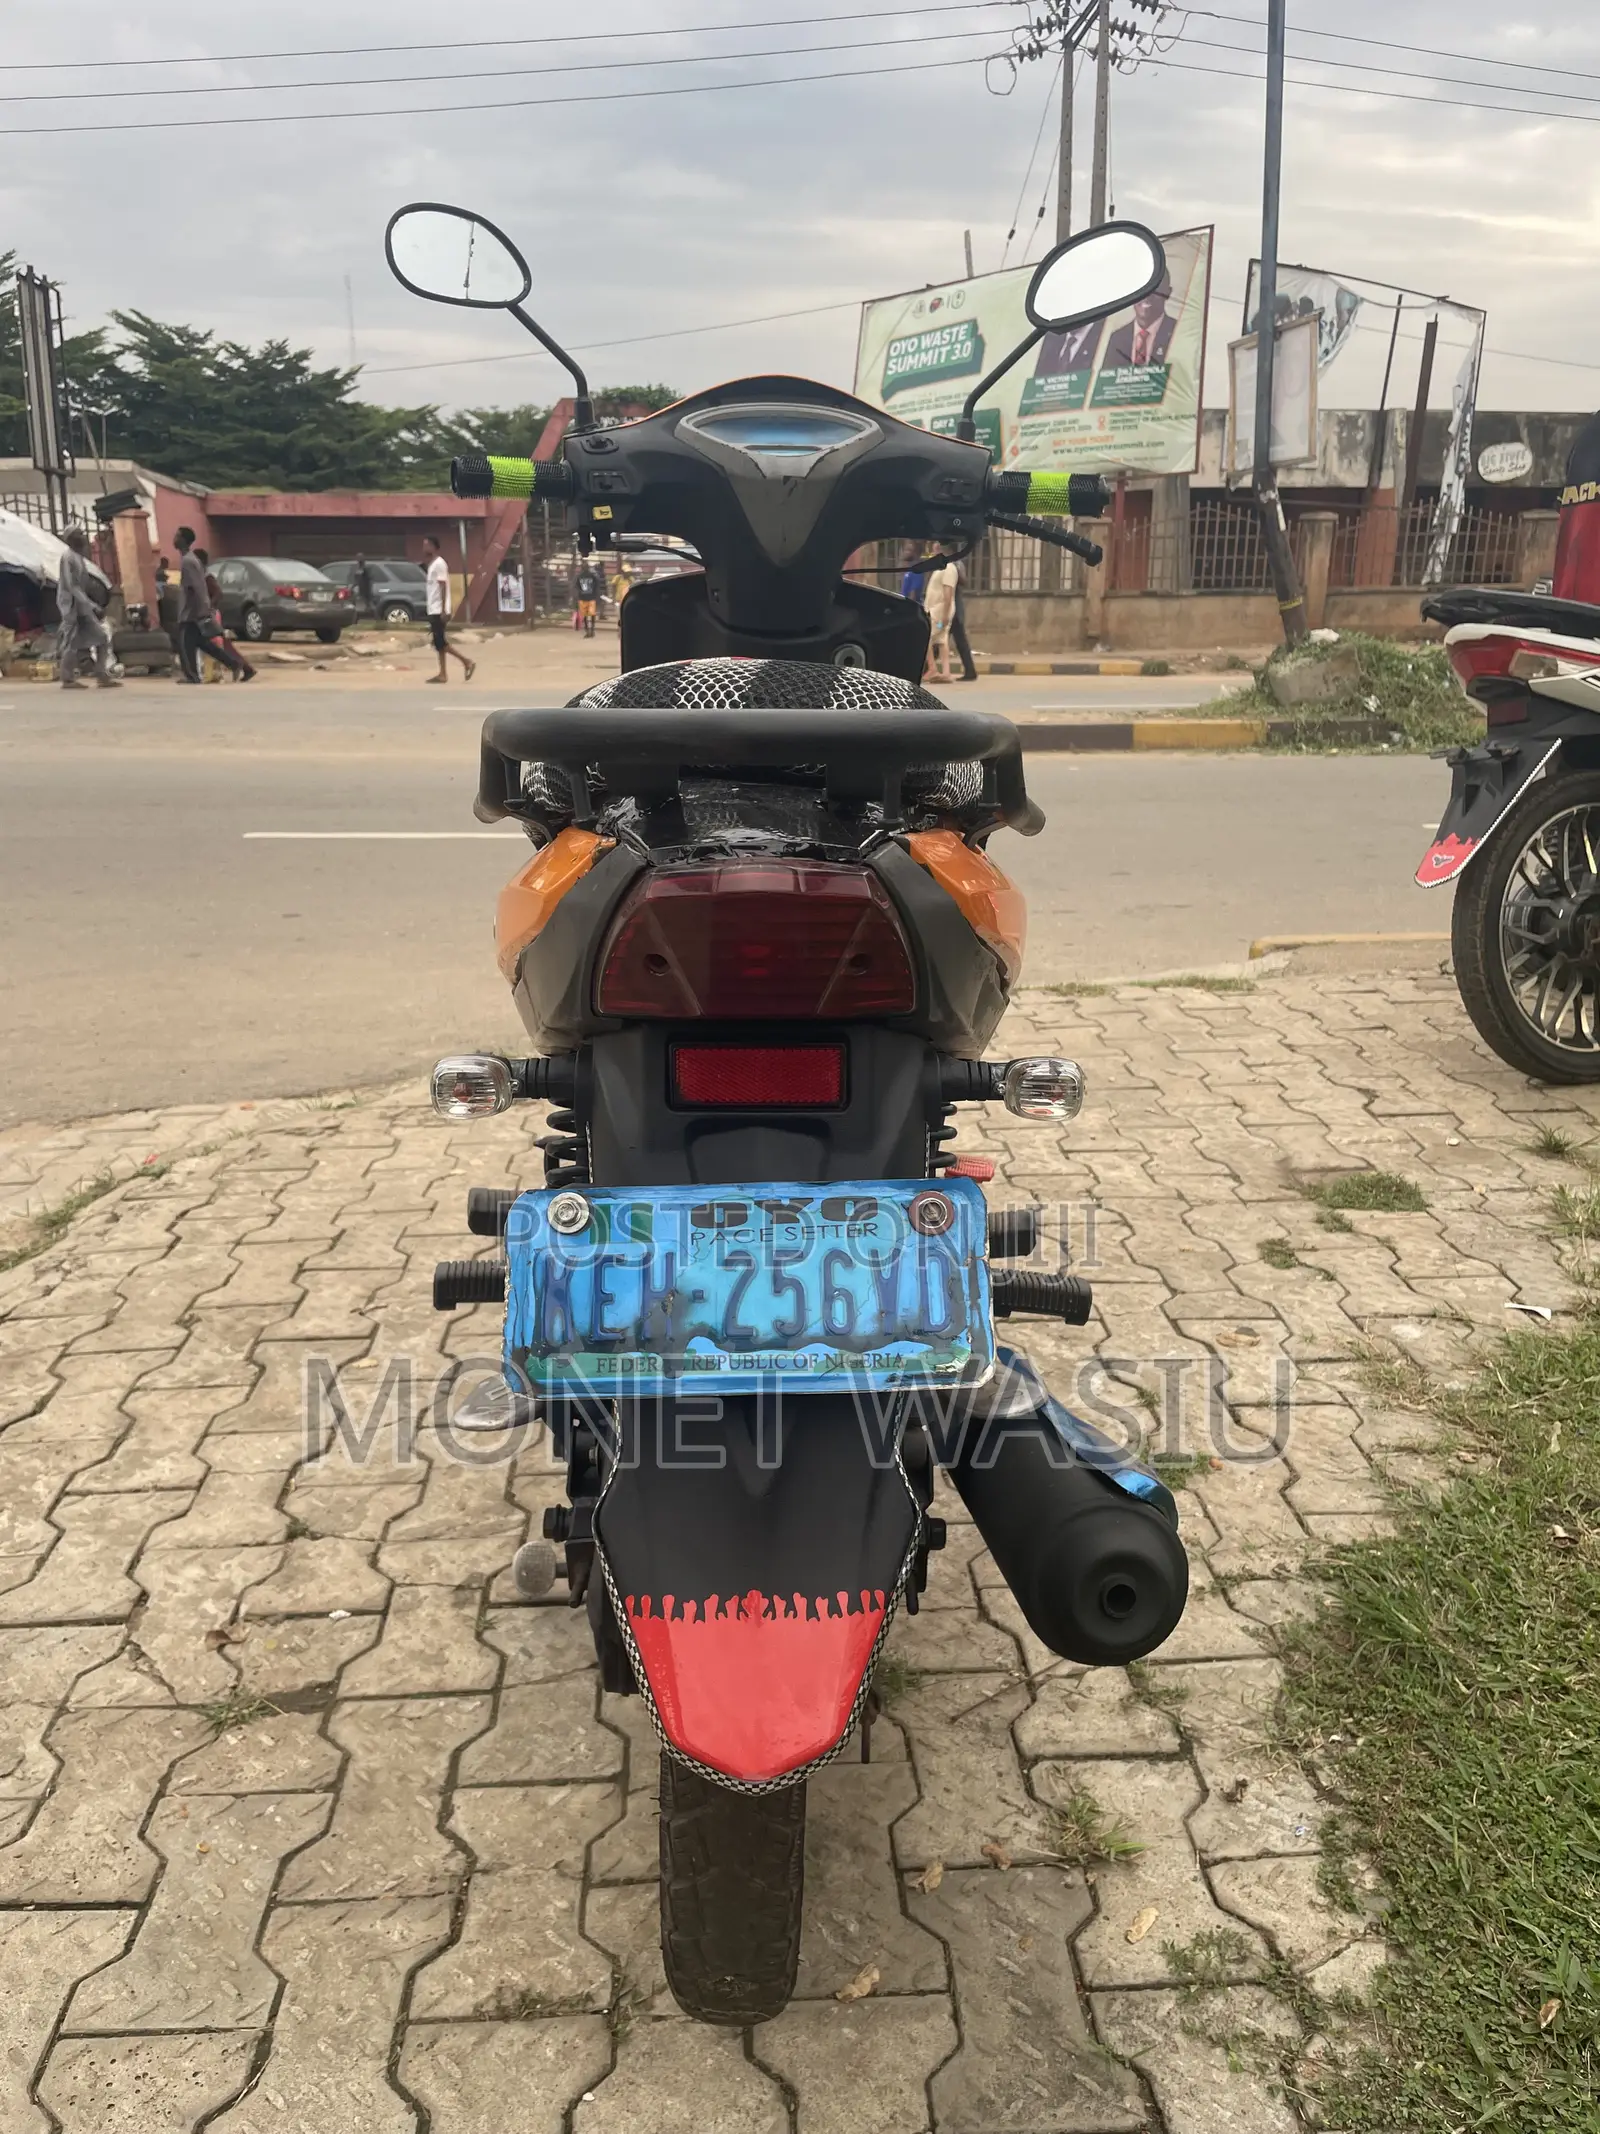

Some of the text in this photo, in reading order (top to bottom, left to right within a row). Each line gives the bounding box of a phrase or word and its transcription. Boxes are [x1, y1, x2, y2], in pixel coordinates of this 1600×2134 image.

[889, 324, 969, 357] OYO WASTE
[887, 341, 972, 375] SUMMIT 3.0
[690, 1195, 879, 1229] OYO
[690, 1221, 879, 1246] PACE SETTER
[596, 1352, 905, 1373] FEDER REPUBLIC OF NIGERIA
